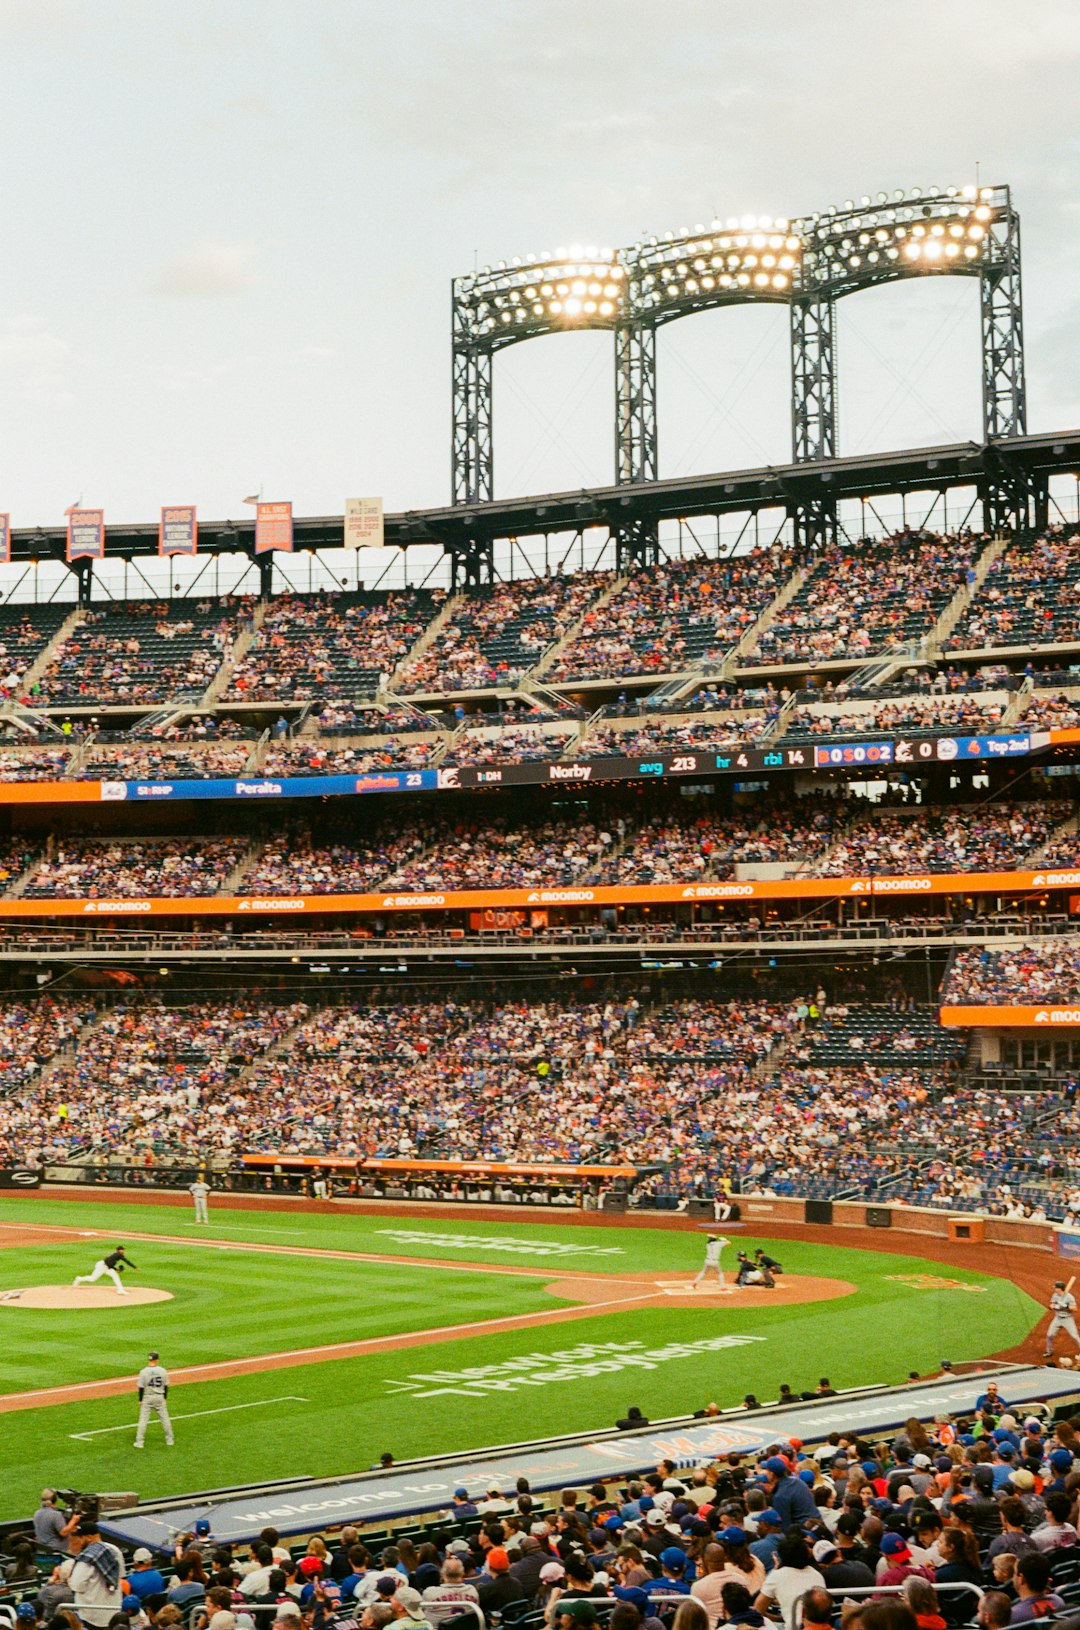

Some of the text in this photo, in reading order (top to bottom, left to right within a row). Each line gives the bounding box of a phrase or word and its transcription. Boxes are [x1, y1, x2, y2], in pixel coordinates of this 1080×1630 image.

[919, 742, 932, 757] 0
[967, 740, 980, 754] 4
[987, 738, 1029, 755] Top 2nd
[639, 750, 804, 775] avg .213 hr 4 rbi 14
[549, 763, 592, 780] Norby
[235, 781, 282, 795] Peralta
[356, 774, 422, 793] pitches 23
[540, 891, 594, 901] moomoo
[696, 885, 754, 897] moomoo
[98, 901, 151, 911] moomoo
[252, 900, 305, 909] moomoo
[395, 896, 445, 906] moomoo
[147, 1376, 162, 1387] 45
[652, 1431, 764, 1459] Mets
[232, 1489, 401, 1523] welcome
[403, 1480, 449, 1494] to
[452, 1472, 513, 1487] citi
